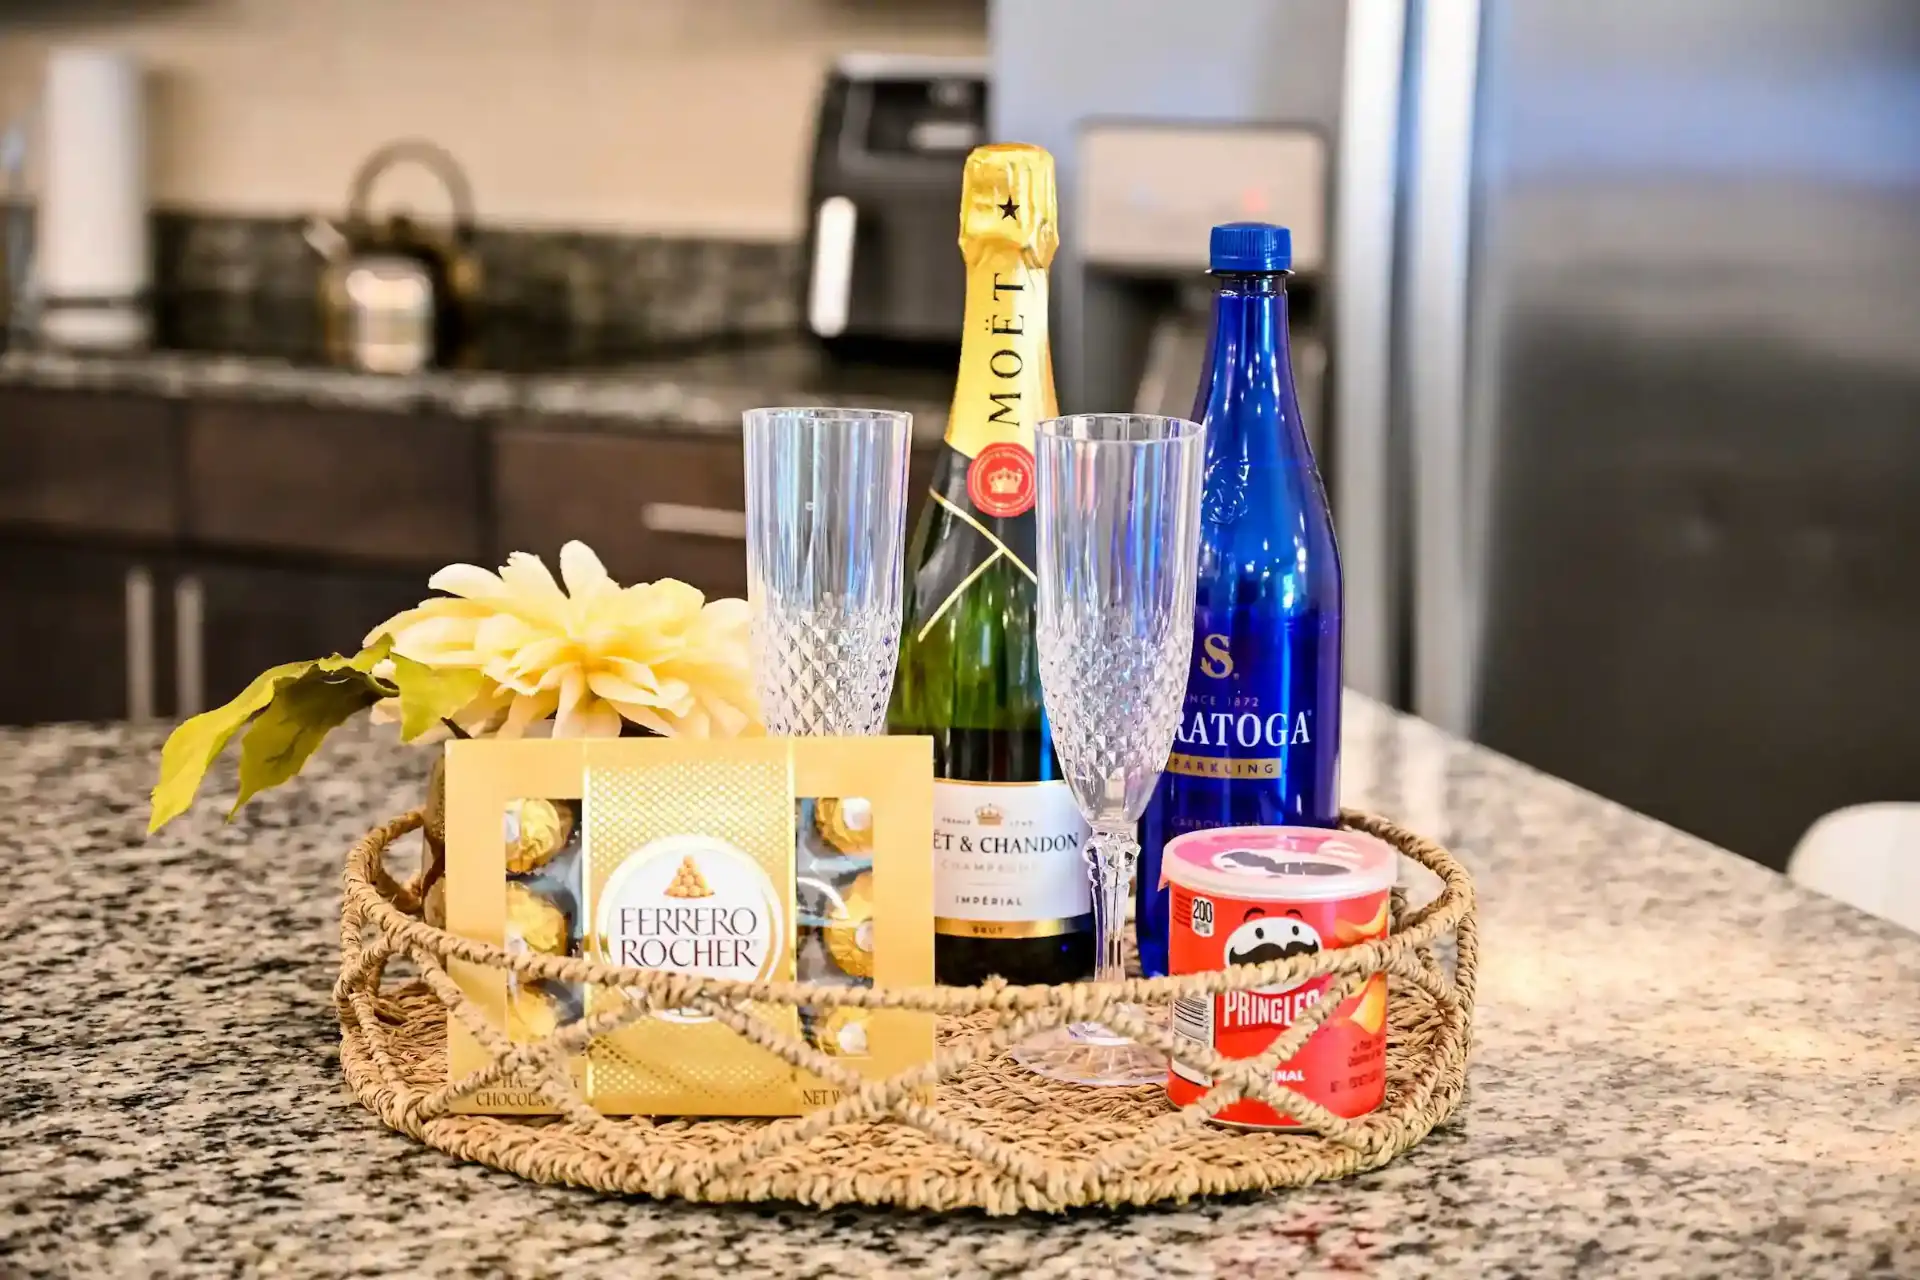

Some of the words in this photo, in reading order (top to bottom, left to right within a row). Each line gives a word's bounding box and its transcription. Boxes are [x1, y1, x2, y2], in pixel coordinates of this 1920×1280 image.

[985, 272, 1026, 427] MOËT
[1228, 696, 1260, 707] 1872
[960, 836, 973, 852] &
[980, 831, 1079, 854] CHANDON
[956, 894, 1023, 907] IMPÉRIAL
[1193, 898, 1213, 923] 200
[620, 907, 757, 936] FERRERO
[972, 925, 1004, 935] BRUT
[803, 1089, 828, 1105] NET
